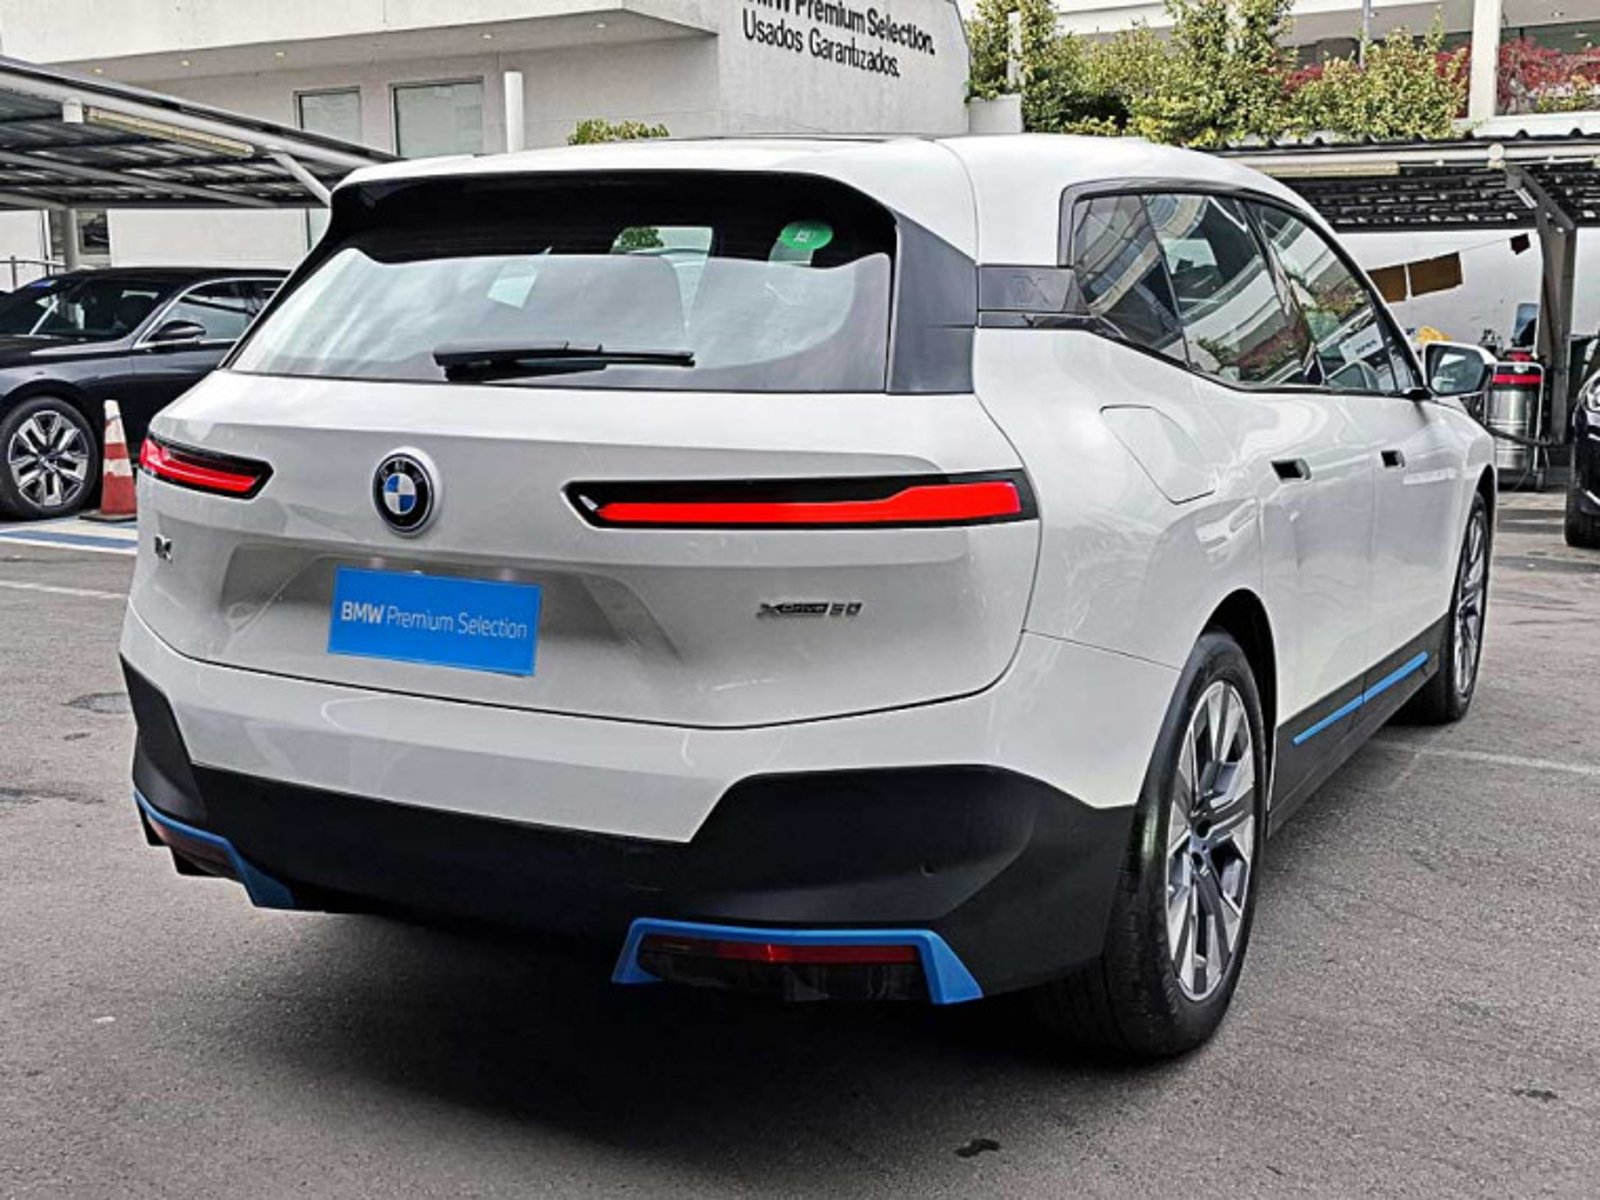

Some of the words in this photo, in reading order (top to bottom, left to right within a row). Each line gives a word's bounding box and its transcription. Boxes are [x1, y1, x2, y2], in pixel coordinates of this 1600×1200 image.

[742, 8, 803, 53] Usados
[340, 601, 384, 624] BMW
[386, 605, 454, 632] Premium
[457, 612, 528, 639] Selection
